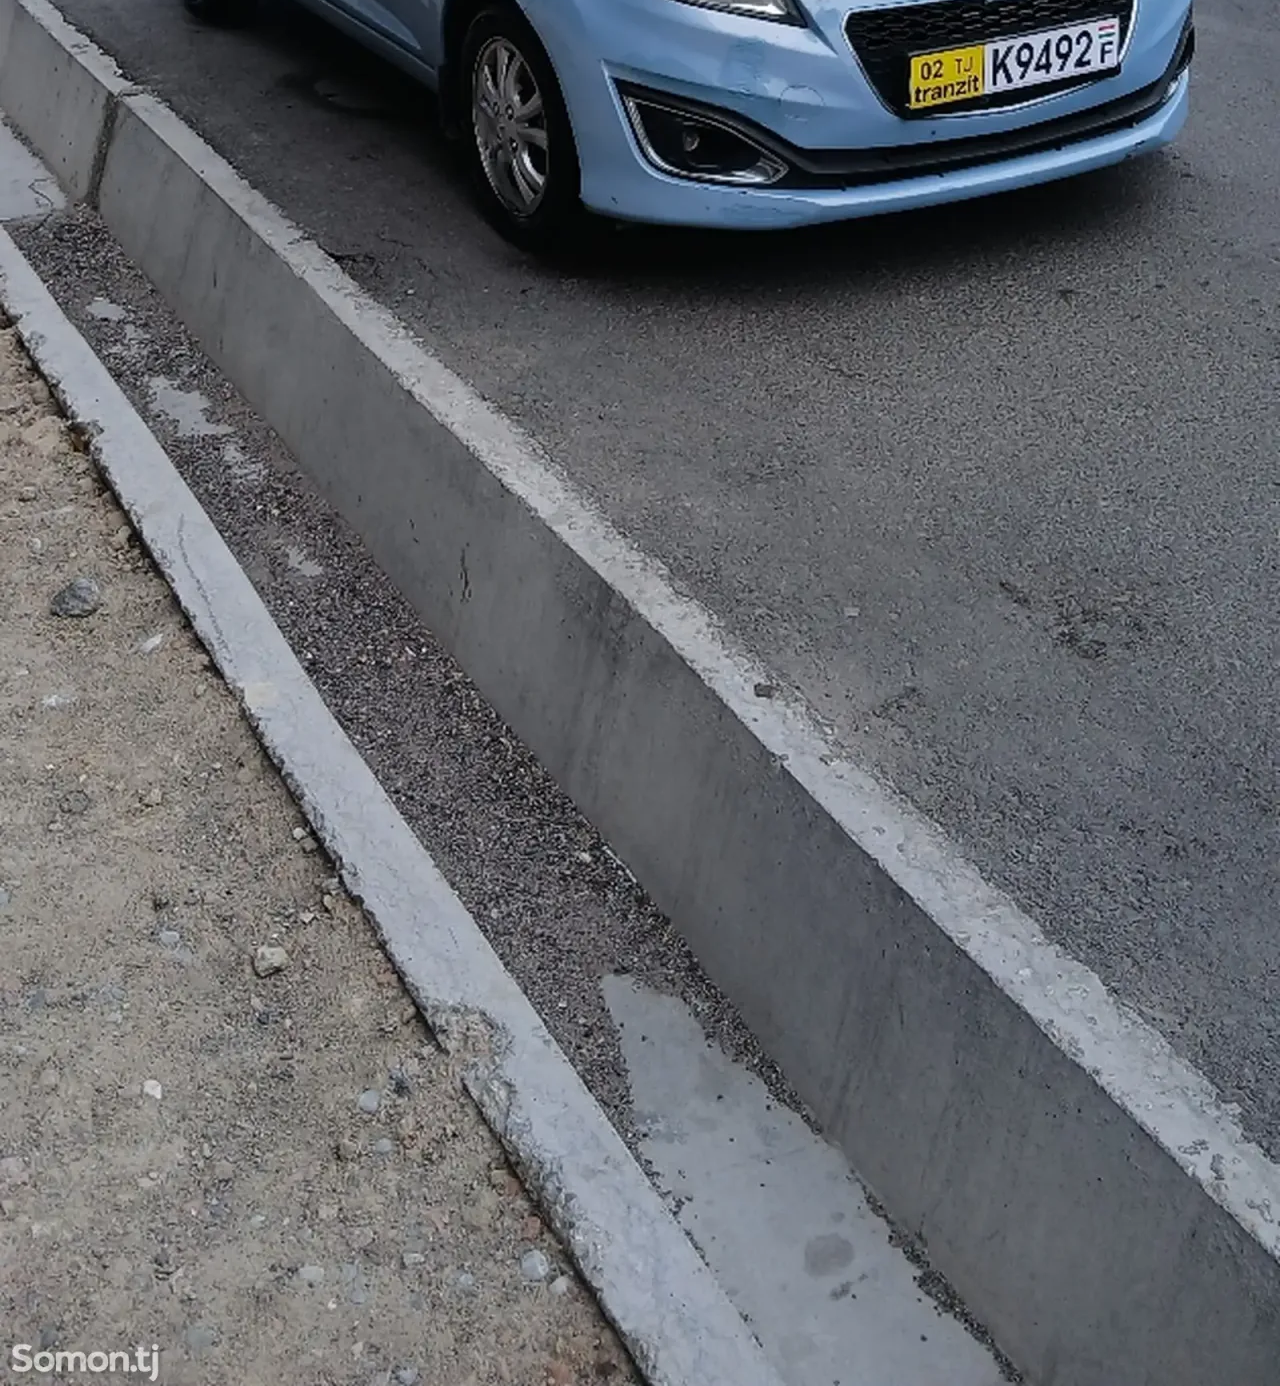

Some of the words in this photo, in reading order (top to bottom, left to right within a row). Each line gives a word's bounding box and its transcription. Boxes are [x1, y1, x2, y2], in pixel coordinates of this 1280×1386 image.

[992, 30, 1093, 86] K9492
[1100, 41, 1114, 64] F
[920, 59, 944, 80] 02
[955, 56, 974, 76] TJ
[915, 75, 980, 103] tranzit
